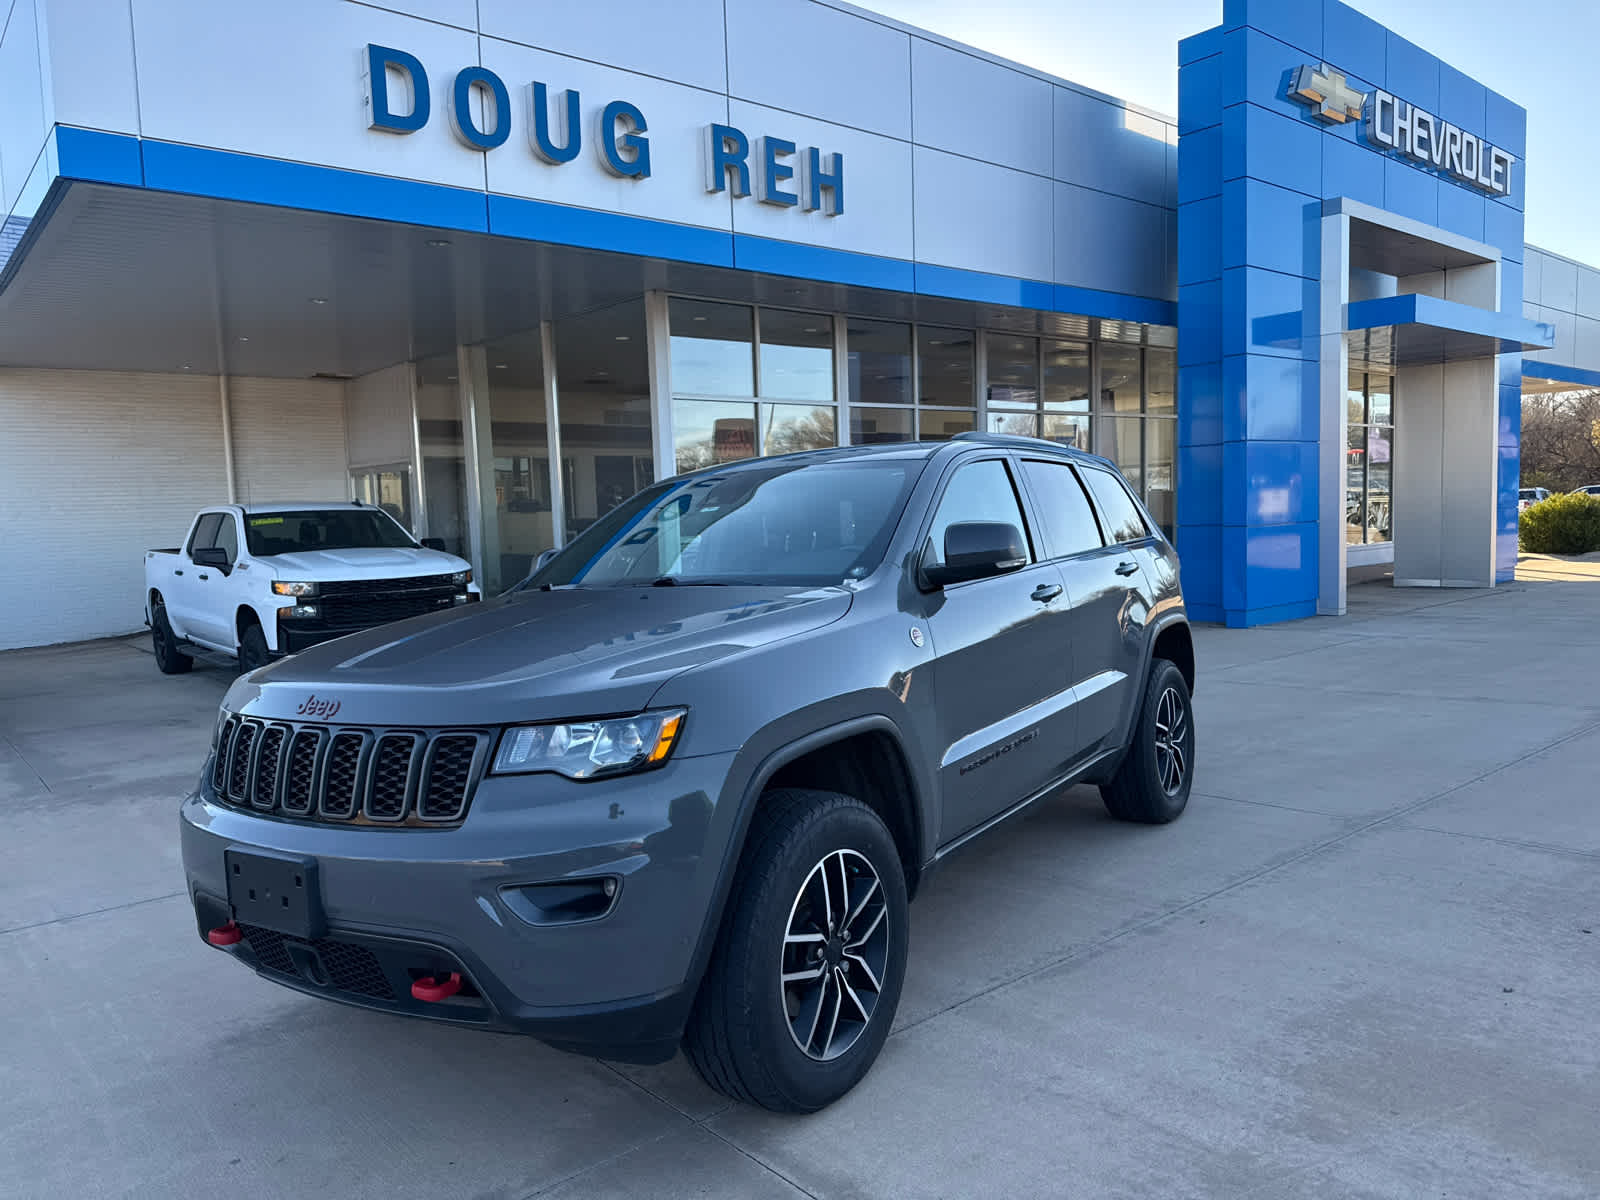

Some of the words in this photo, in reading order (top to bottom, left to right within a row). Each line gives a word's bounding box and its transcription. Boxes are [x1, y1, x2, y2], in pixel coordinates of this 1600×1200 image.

[366, 43, 651, 180] DOUG
[706, 122, 845, 217] REH
[1374, 89, 1516, 196] CHEVROLET
[295, 694, 341, 720] Jeep
